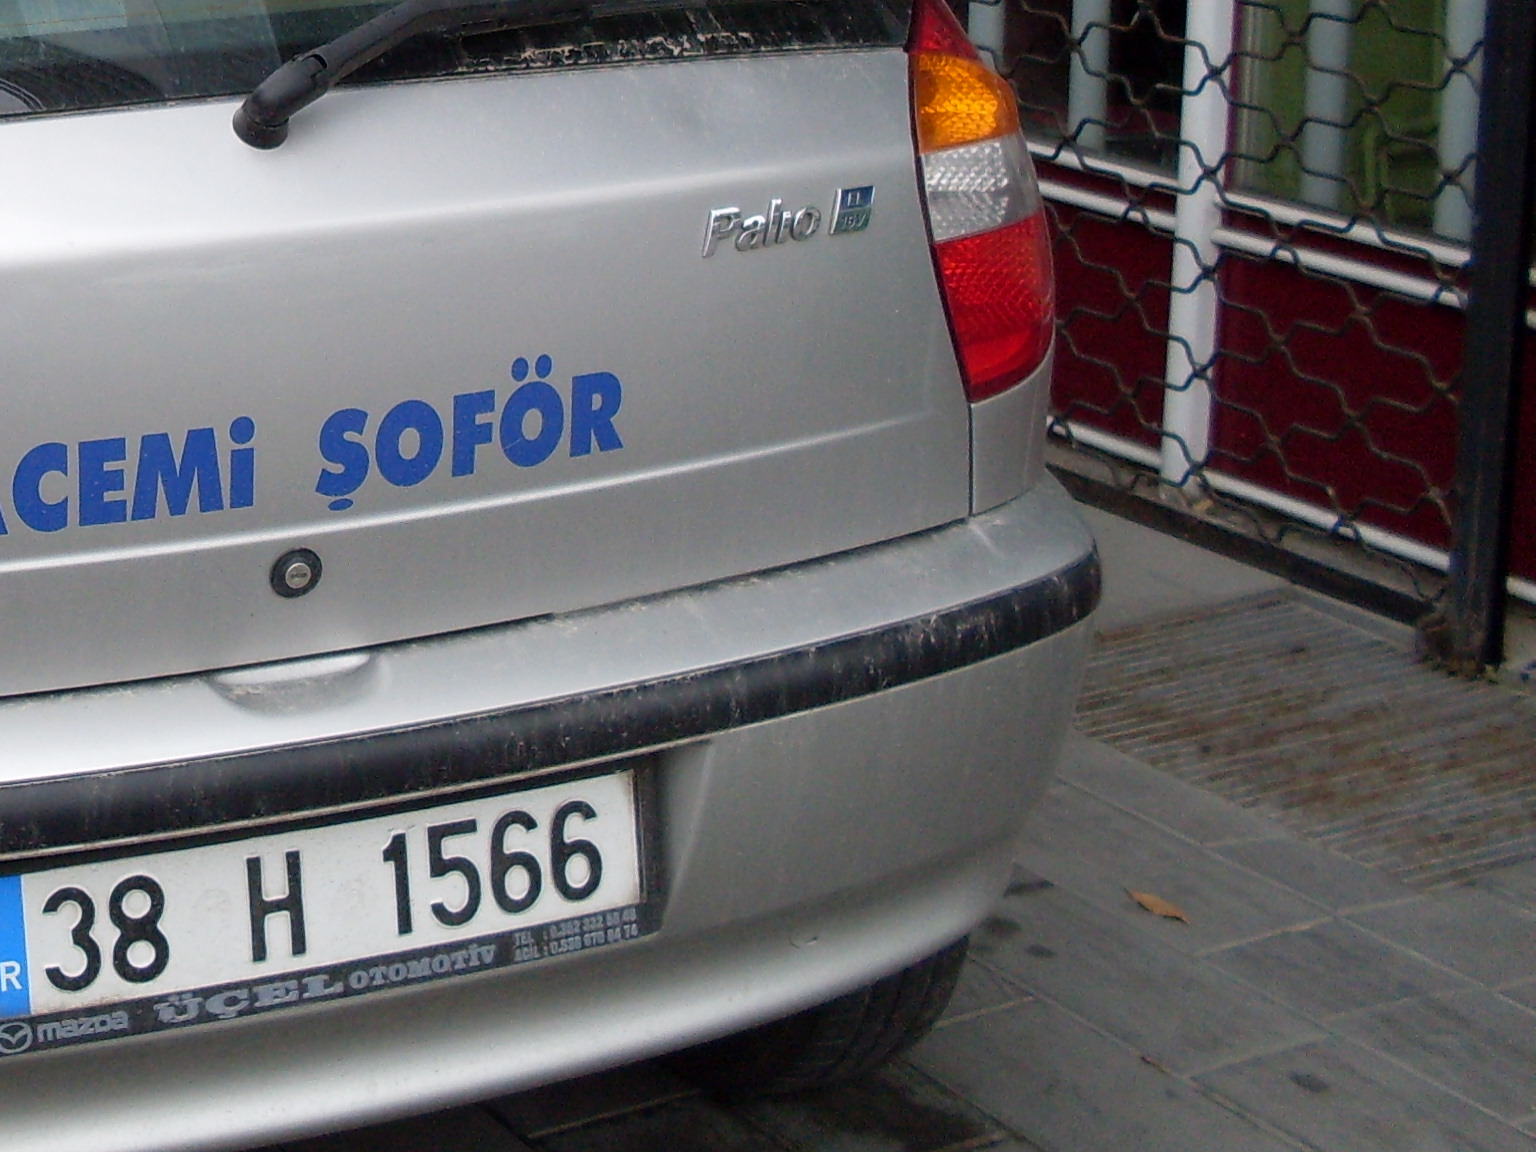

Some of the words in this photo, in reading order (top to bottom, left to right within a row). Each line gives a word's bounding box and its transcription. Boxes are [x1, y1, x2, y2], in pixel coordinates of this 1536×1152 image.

[701, 198, 821, 258] Palio
[314, 354, 623, 511] ŞOFÖR
[41, 874, 170, 993] 38
[244, 850, 307, 963] H
[382, 800, 605, 936] 1566
[37, 1010, 129, 1043] mazda
[154, 974, 344, 1024] ÜÇEL
